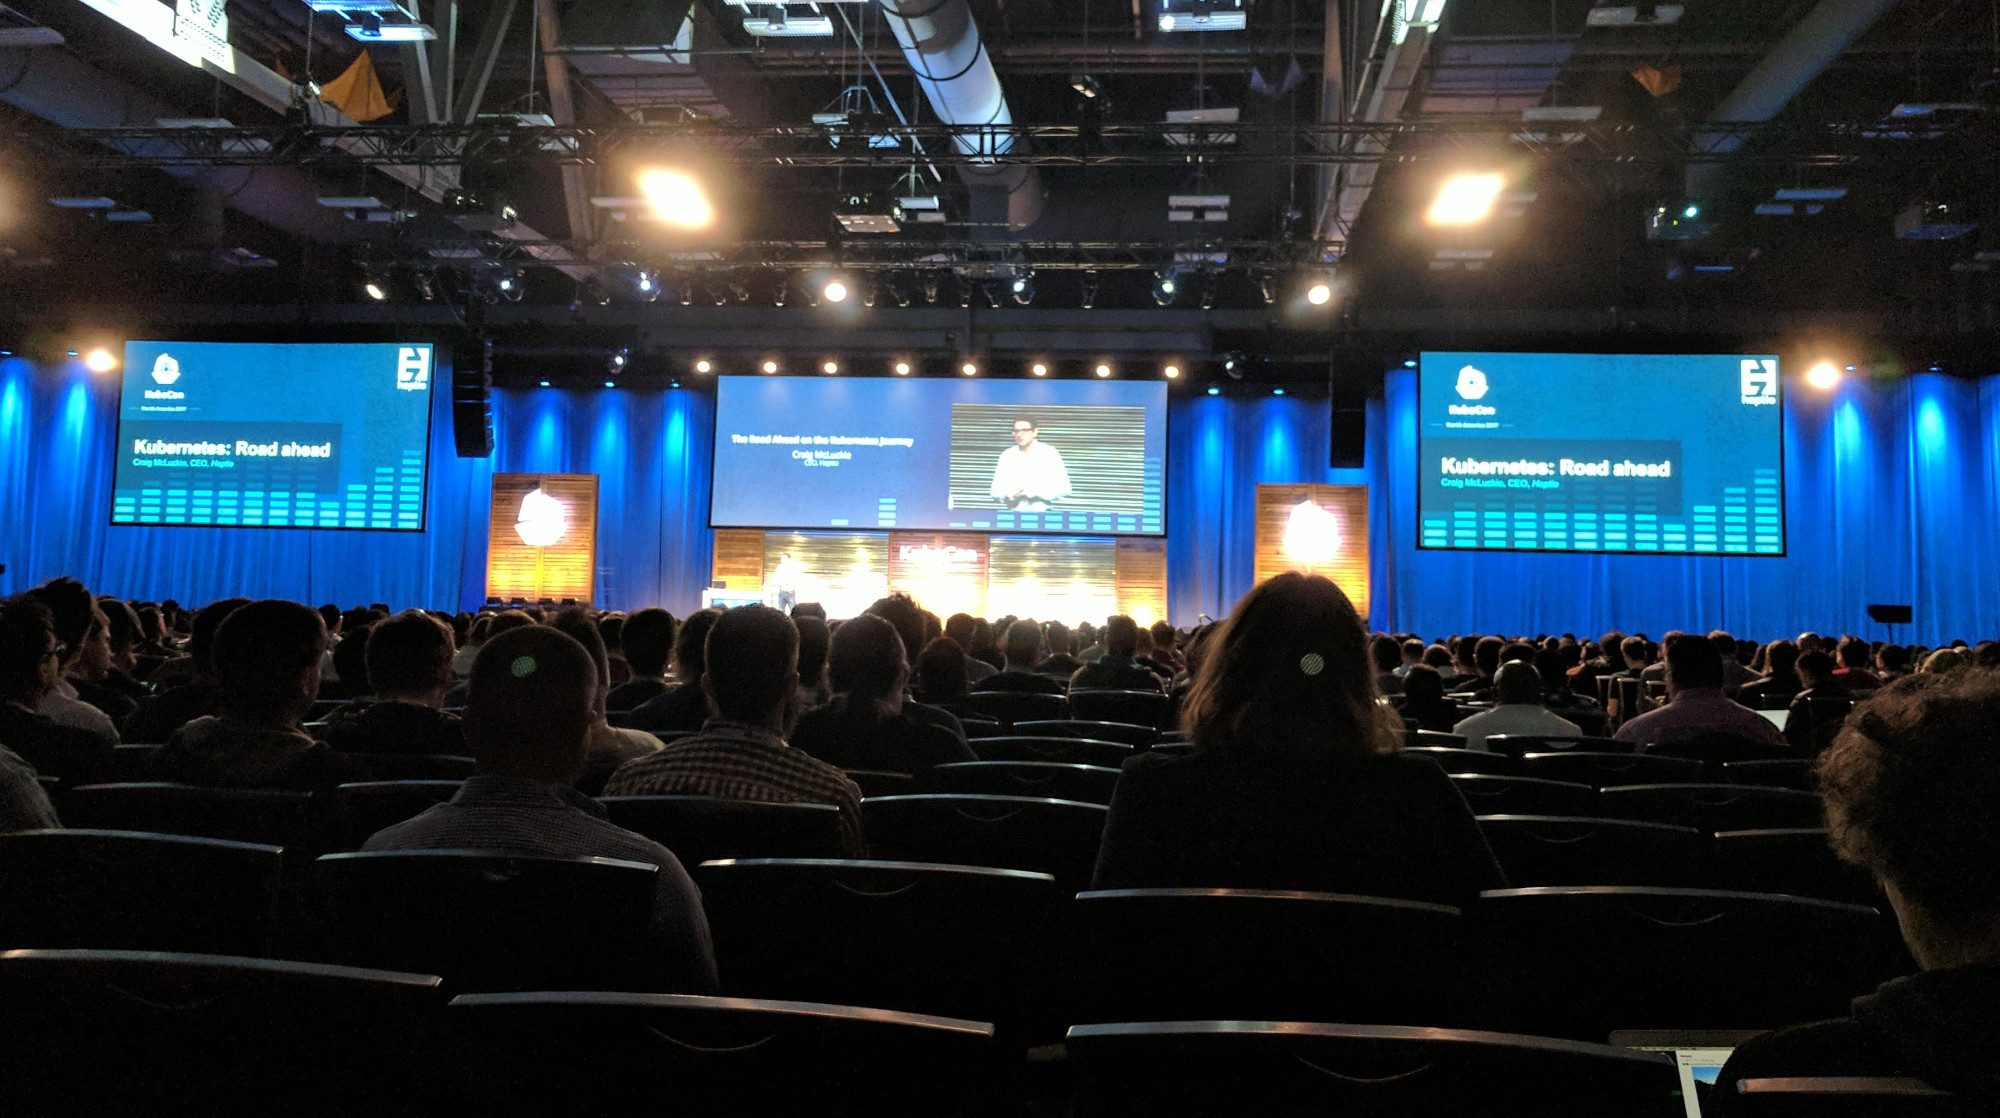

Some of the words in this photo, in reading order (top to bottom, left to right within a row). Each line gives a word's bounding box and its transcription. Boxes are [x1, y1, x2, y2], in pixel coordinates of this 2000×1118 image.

[731, 433, 748, 444] The
[749, 433, 772, 444] Road
[772, 434, 800, 445] Ahead
[800, 436, 813, 445] on
[813, 435, 829, 445] the
[829, 435, 879, 446] Kubernetes
[133, 438, 231, 457] Kubernetes:
[235, 440, 278, 457] Road
[281, 441, 332, 459] ahead
[791, 449, 814, 462] Craig
[133, 458, 152, 468] Craig
[190, 459, 210, 468] CEO,
[1441, 457, 1555, 476] Kubernetes:
[1559, 458, 1609, 477] Road
[1613, 460, 1671, 478] ahead
[1440, 477, 1464, 489] Craig
[1507, 478, 1530, 489] CEO,
[899, 544, 978, 562] KubeCon
